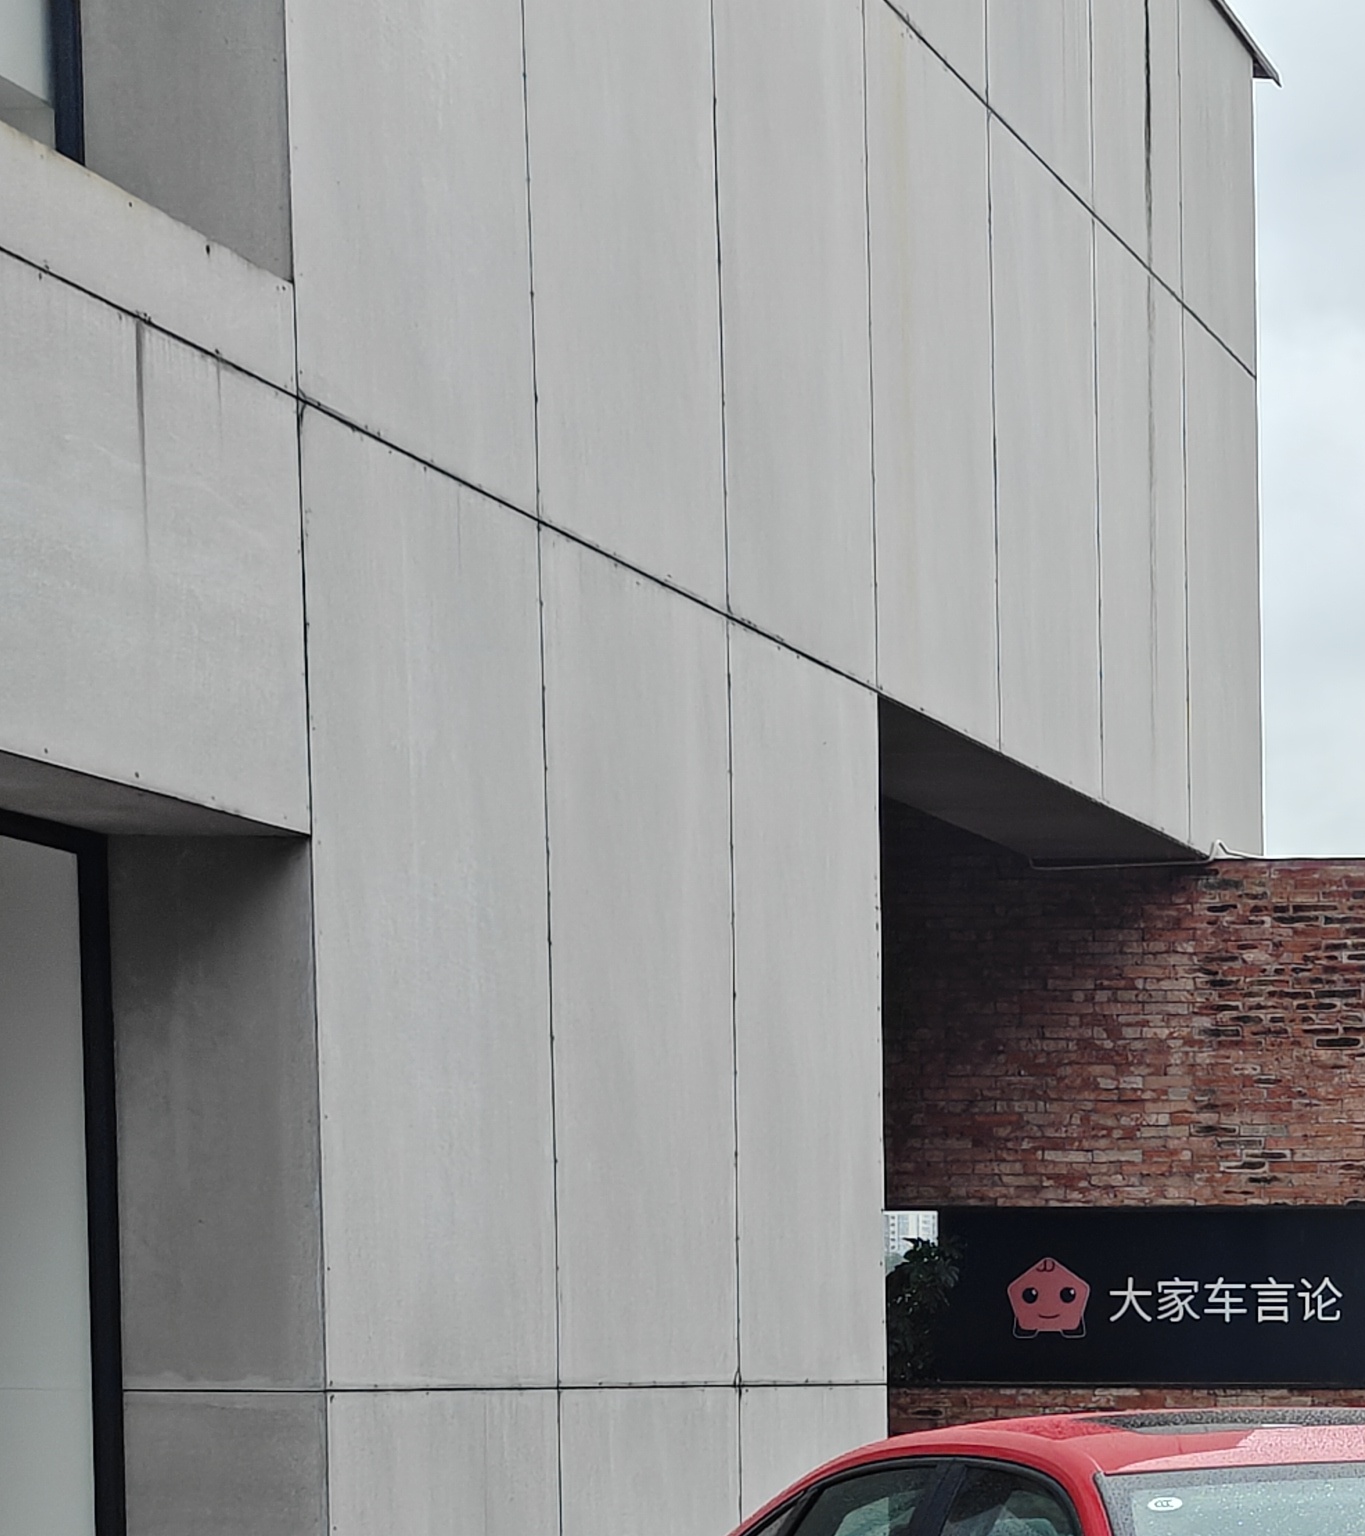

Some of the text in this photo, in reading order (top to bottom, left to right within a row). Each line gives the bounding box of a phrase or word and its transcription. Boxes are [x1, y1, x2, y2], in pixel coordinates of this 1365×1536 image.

[1109, 1276, 1343, 1323] 大家车言论
